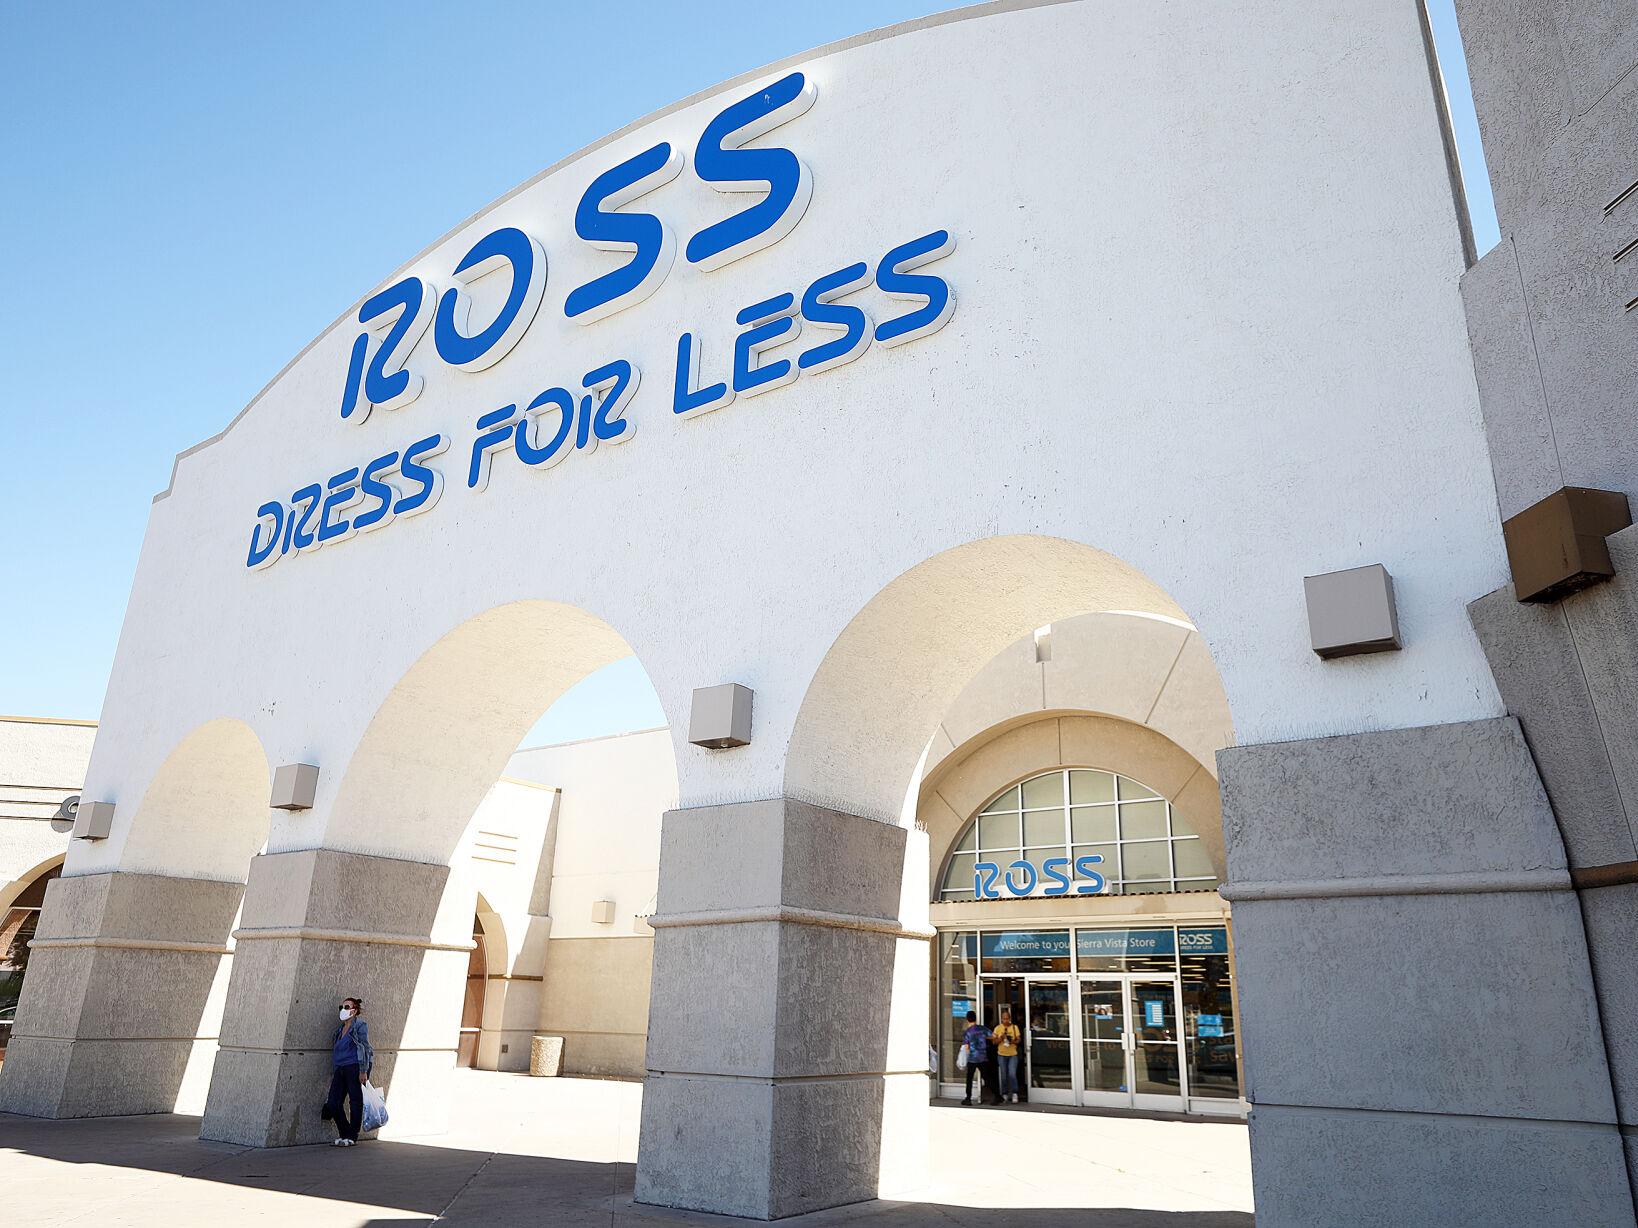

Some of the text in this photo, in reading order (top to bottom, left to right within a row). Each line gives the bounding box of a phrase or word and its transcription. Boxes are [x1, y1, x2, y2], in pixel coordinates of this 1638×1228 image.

[341, 73, 806, 418] ROSS
[247, 230, 949, 567] DRESS FOR LESS
[974, 855, 1104, 899] ROSS
[1000, 937, 1156, 952] Welcome to you Sierra Vista Store
[1179, 933, 1213, 945] ROSS
